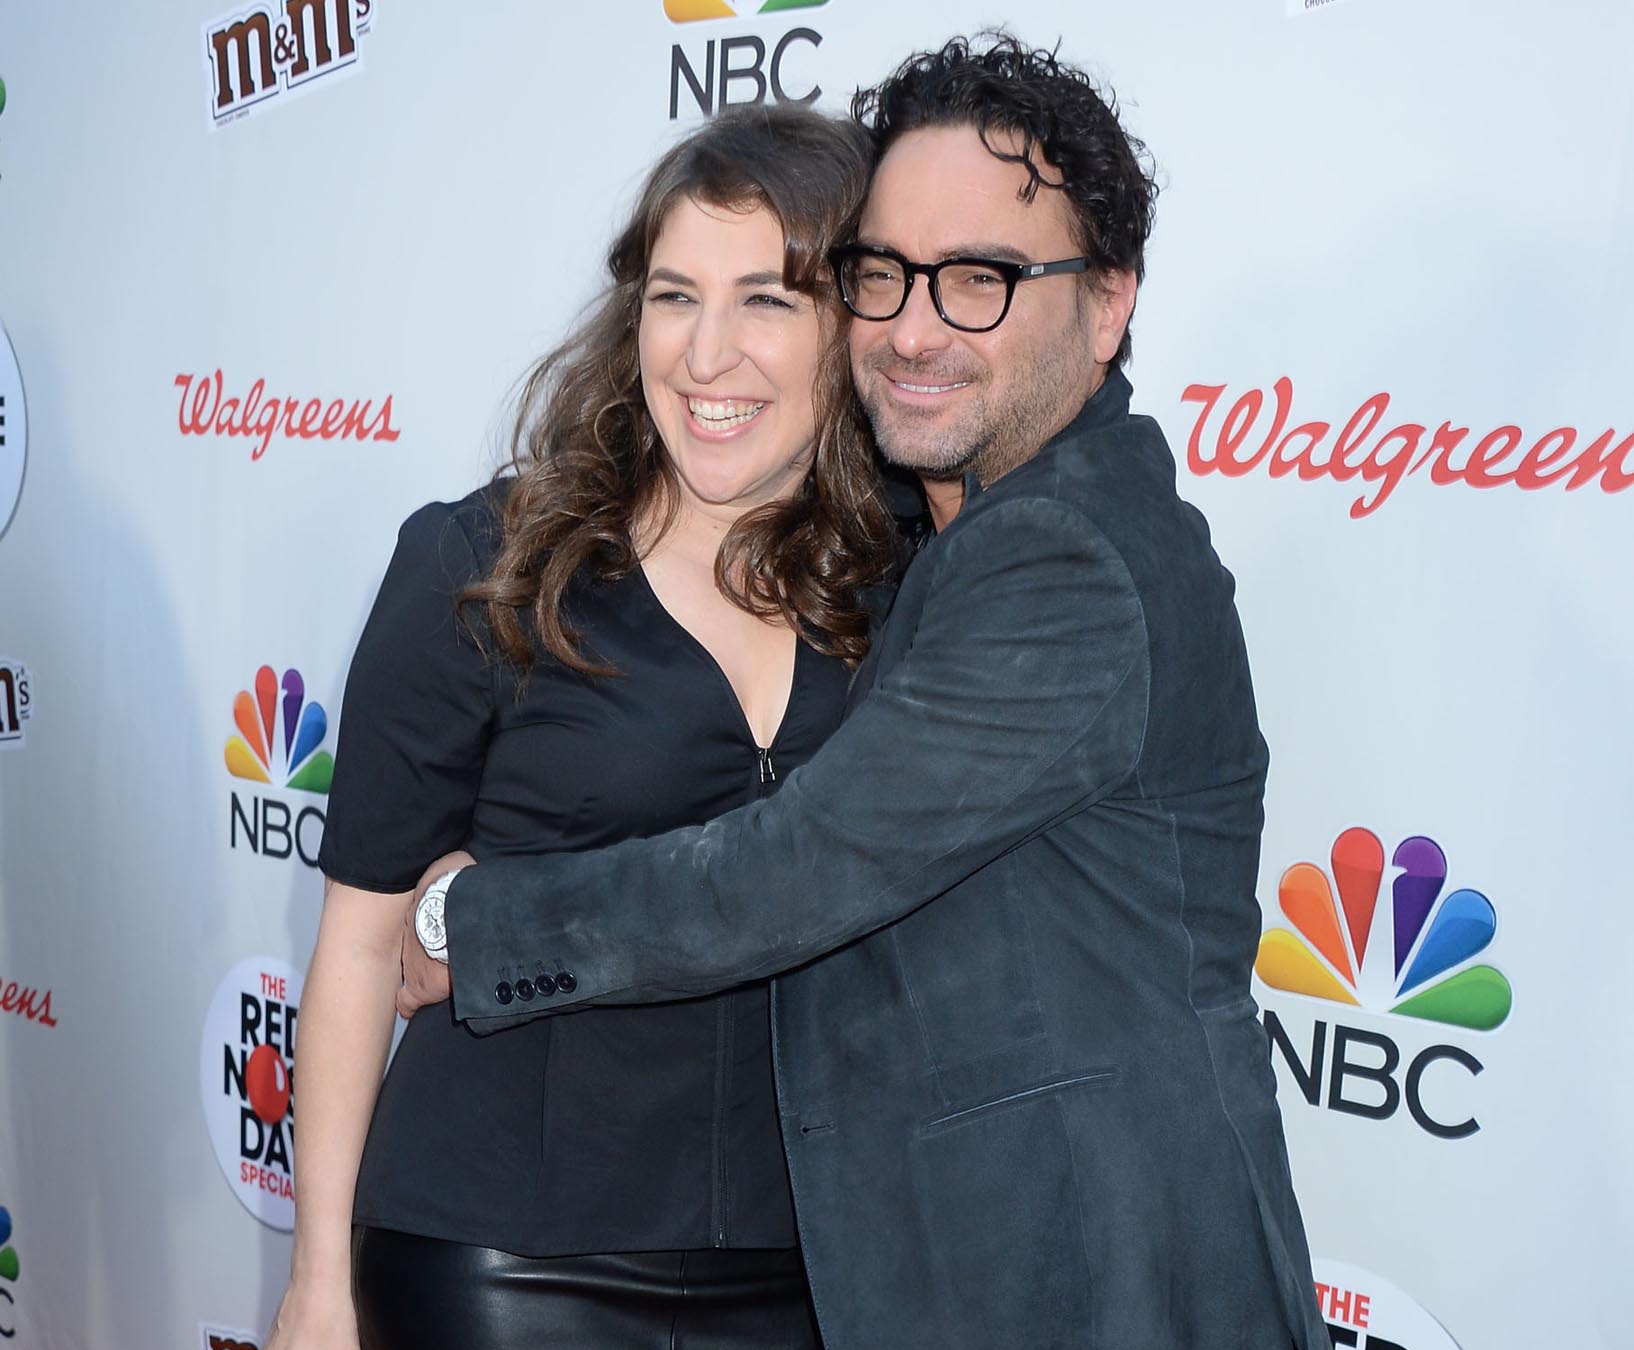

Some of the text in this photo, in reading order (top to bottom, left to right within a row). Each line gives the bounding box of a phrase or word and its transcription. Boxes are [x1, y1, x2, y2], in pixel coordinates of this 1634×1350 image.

[669, 27, 823, 120] NBC
[174, 368, 401, 461] Walgreens
[230, 791, 326, 868] NBC
[260, 972, 286, 1000] THE
[1264, 1009, 1485, 1140] NBC
[240, 1107, 294, 1174] DA
[240, 1161, 295, 1200] SPECIA
[1313, 1281, 1371, 1329] THE
